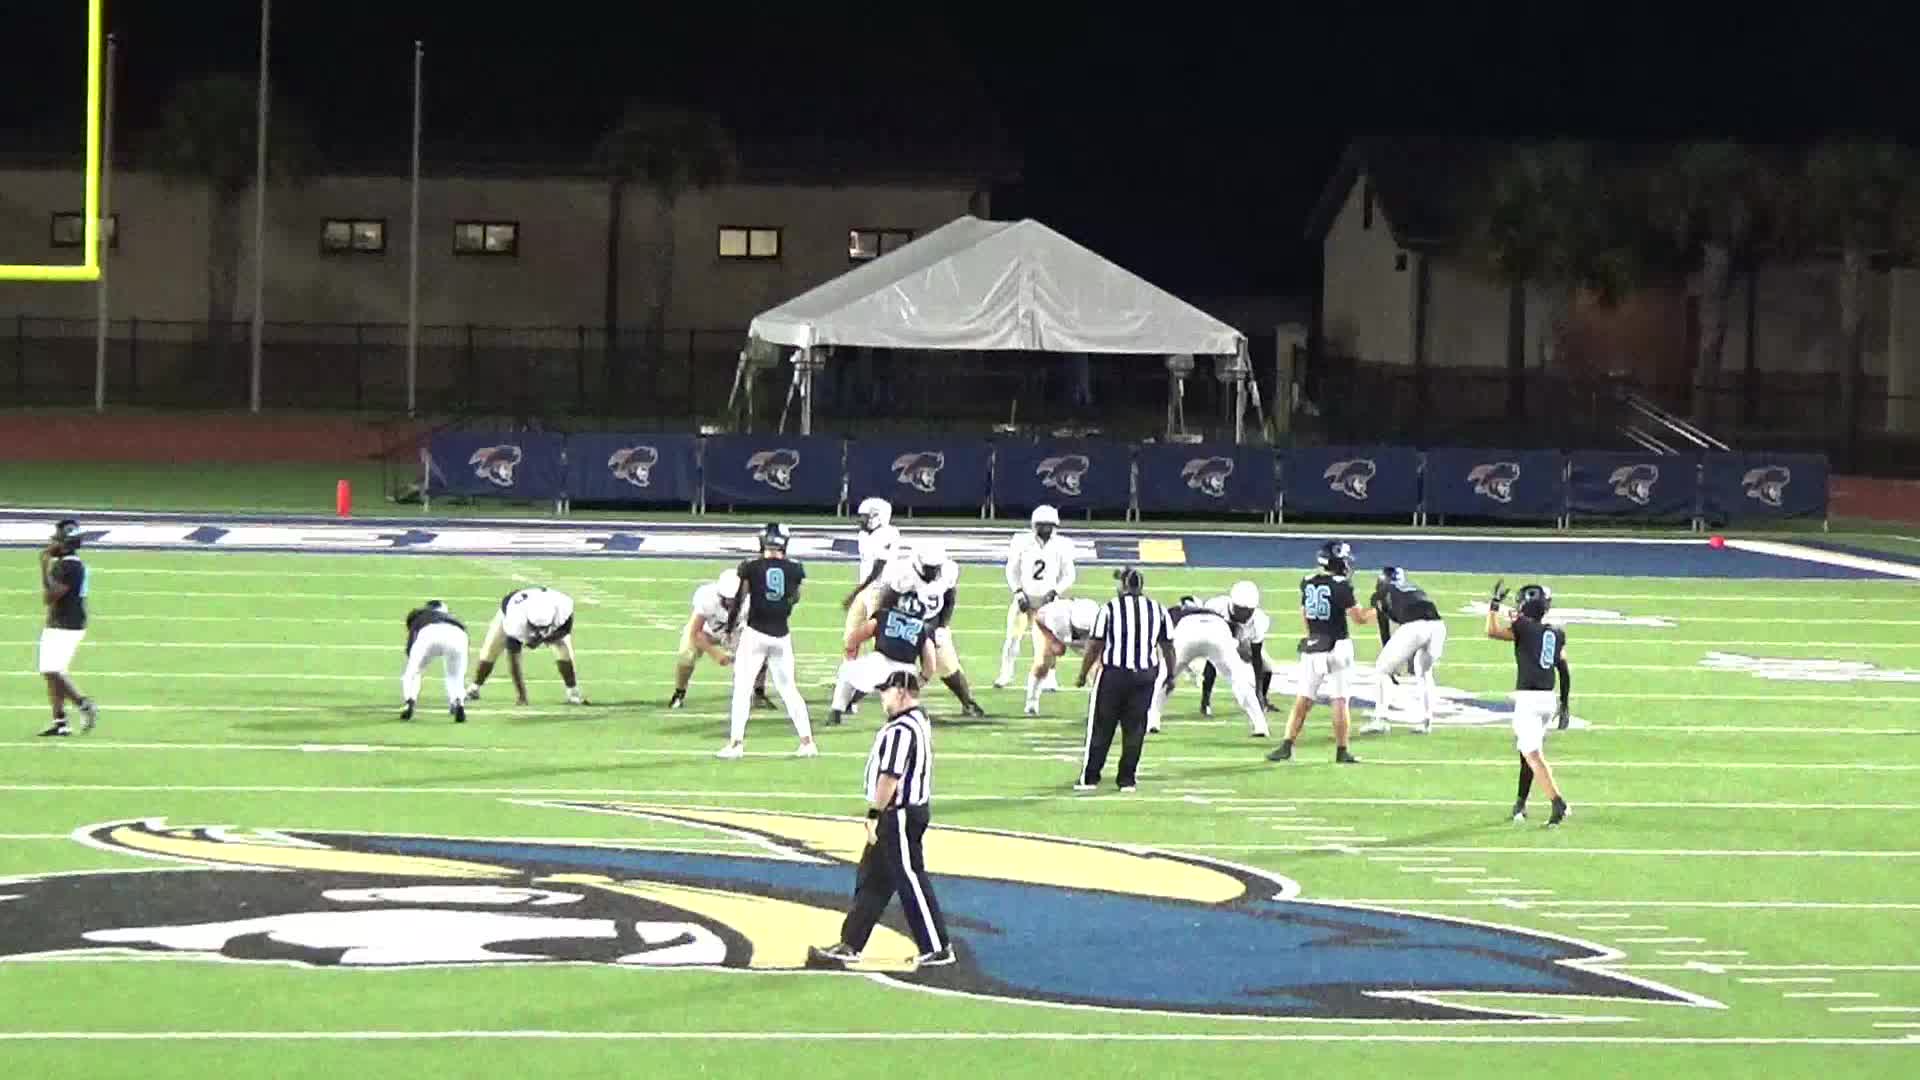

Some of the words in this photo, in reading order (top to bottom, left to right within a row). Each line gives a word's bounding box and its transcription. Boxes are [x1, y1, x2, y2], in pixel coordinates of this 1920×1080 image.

[766, 566, 784, 602] 9
[1032, 559, 1046, 581] 2
[1304, 584, 1331, 621] 26
[885, 610, 923, 646] 52
